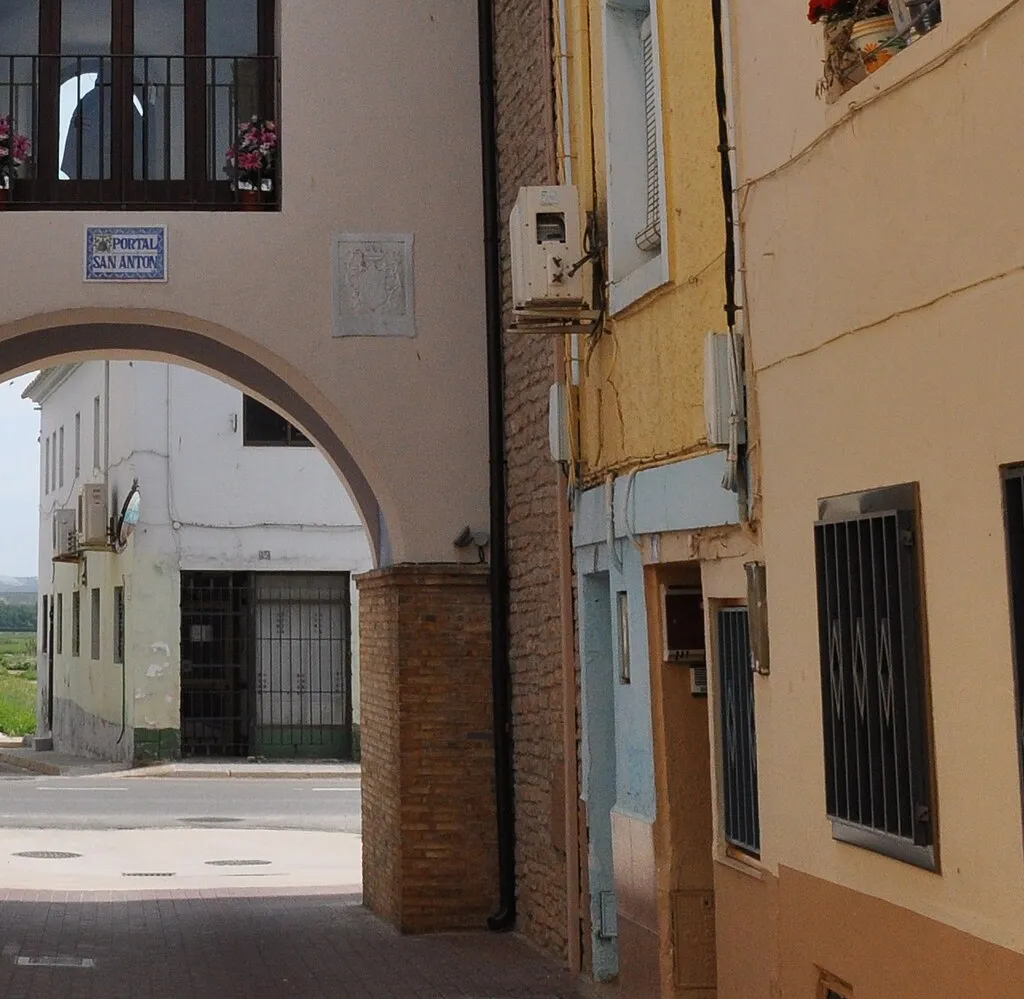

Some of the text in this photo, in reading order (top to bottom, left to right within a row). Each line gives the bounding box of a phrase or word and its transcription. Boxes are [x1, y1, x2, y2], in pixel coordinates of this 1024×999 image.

[112, 237, 158, 250] PORTAL
[92, 255, 158, 269] SAN ANTON
